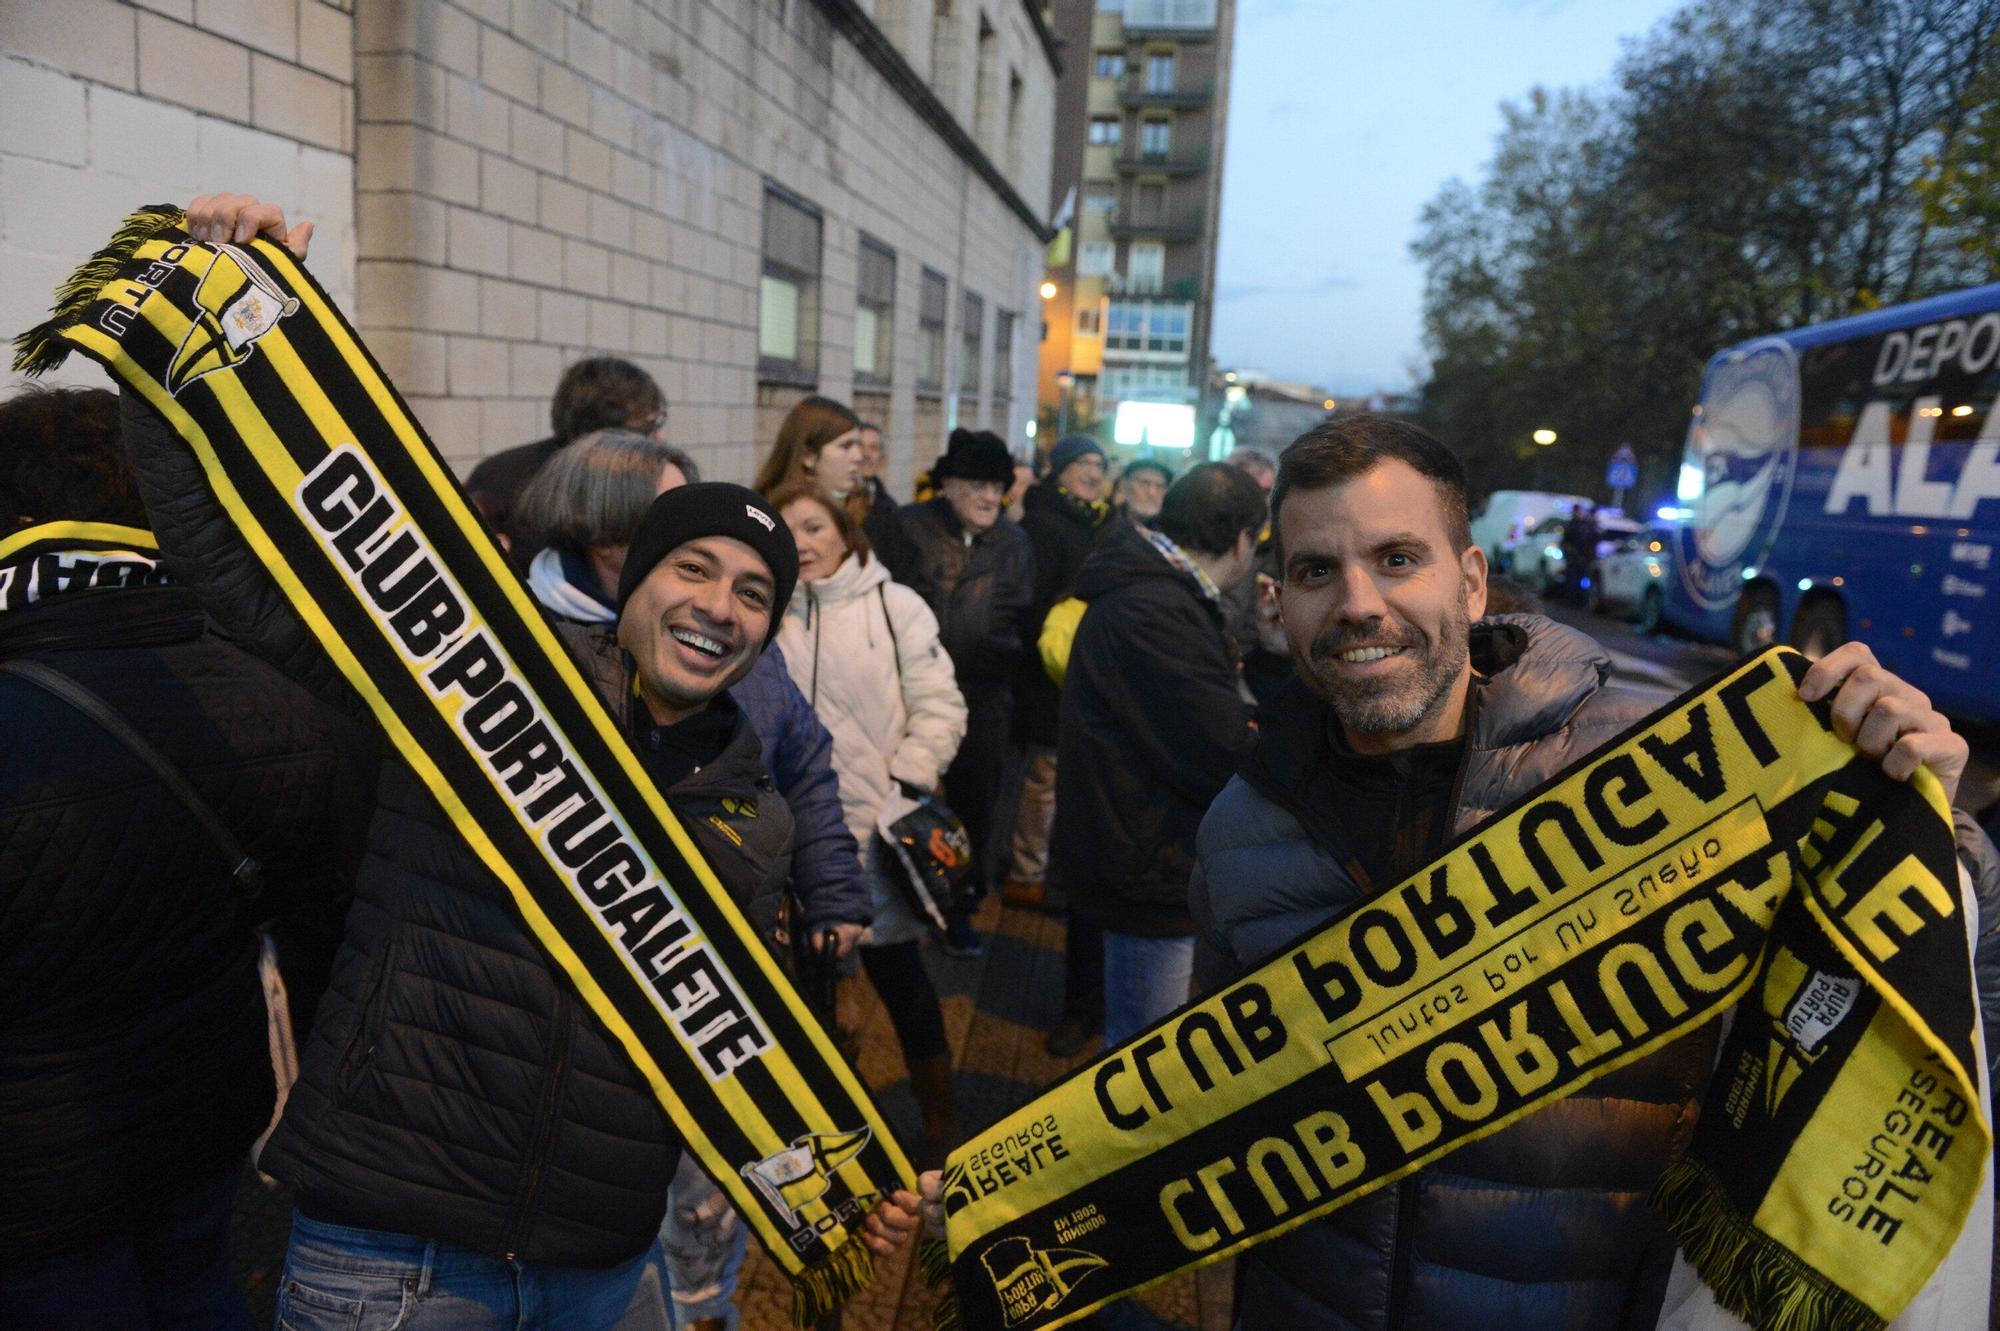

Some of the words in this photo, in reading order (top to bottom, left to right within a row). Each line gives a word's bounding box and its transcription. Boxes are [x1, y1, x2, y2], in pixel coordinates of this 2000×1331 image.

[100, 240, 196, 337] ORTU
[1872, 312, 2000, 386] DEPO
[301, 450, 468, 658] CLUB
[427, 632, 769, 1077] PORTUGALETE
[1816, 982, 1851, 1027] AUPA
[1827, 1068, 1938, 1223] SEGUROS
[1857, 1086, 1969, 1246] REALE
